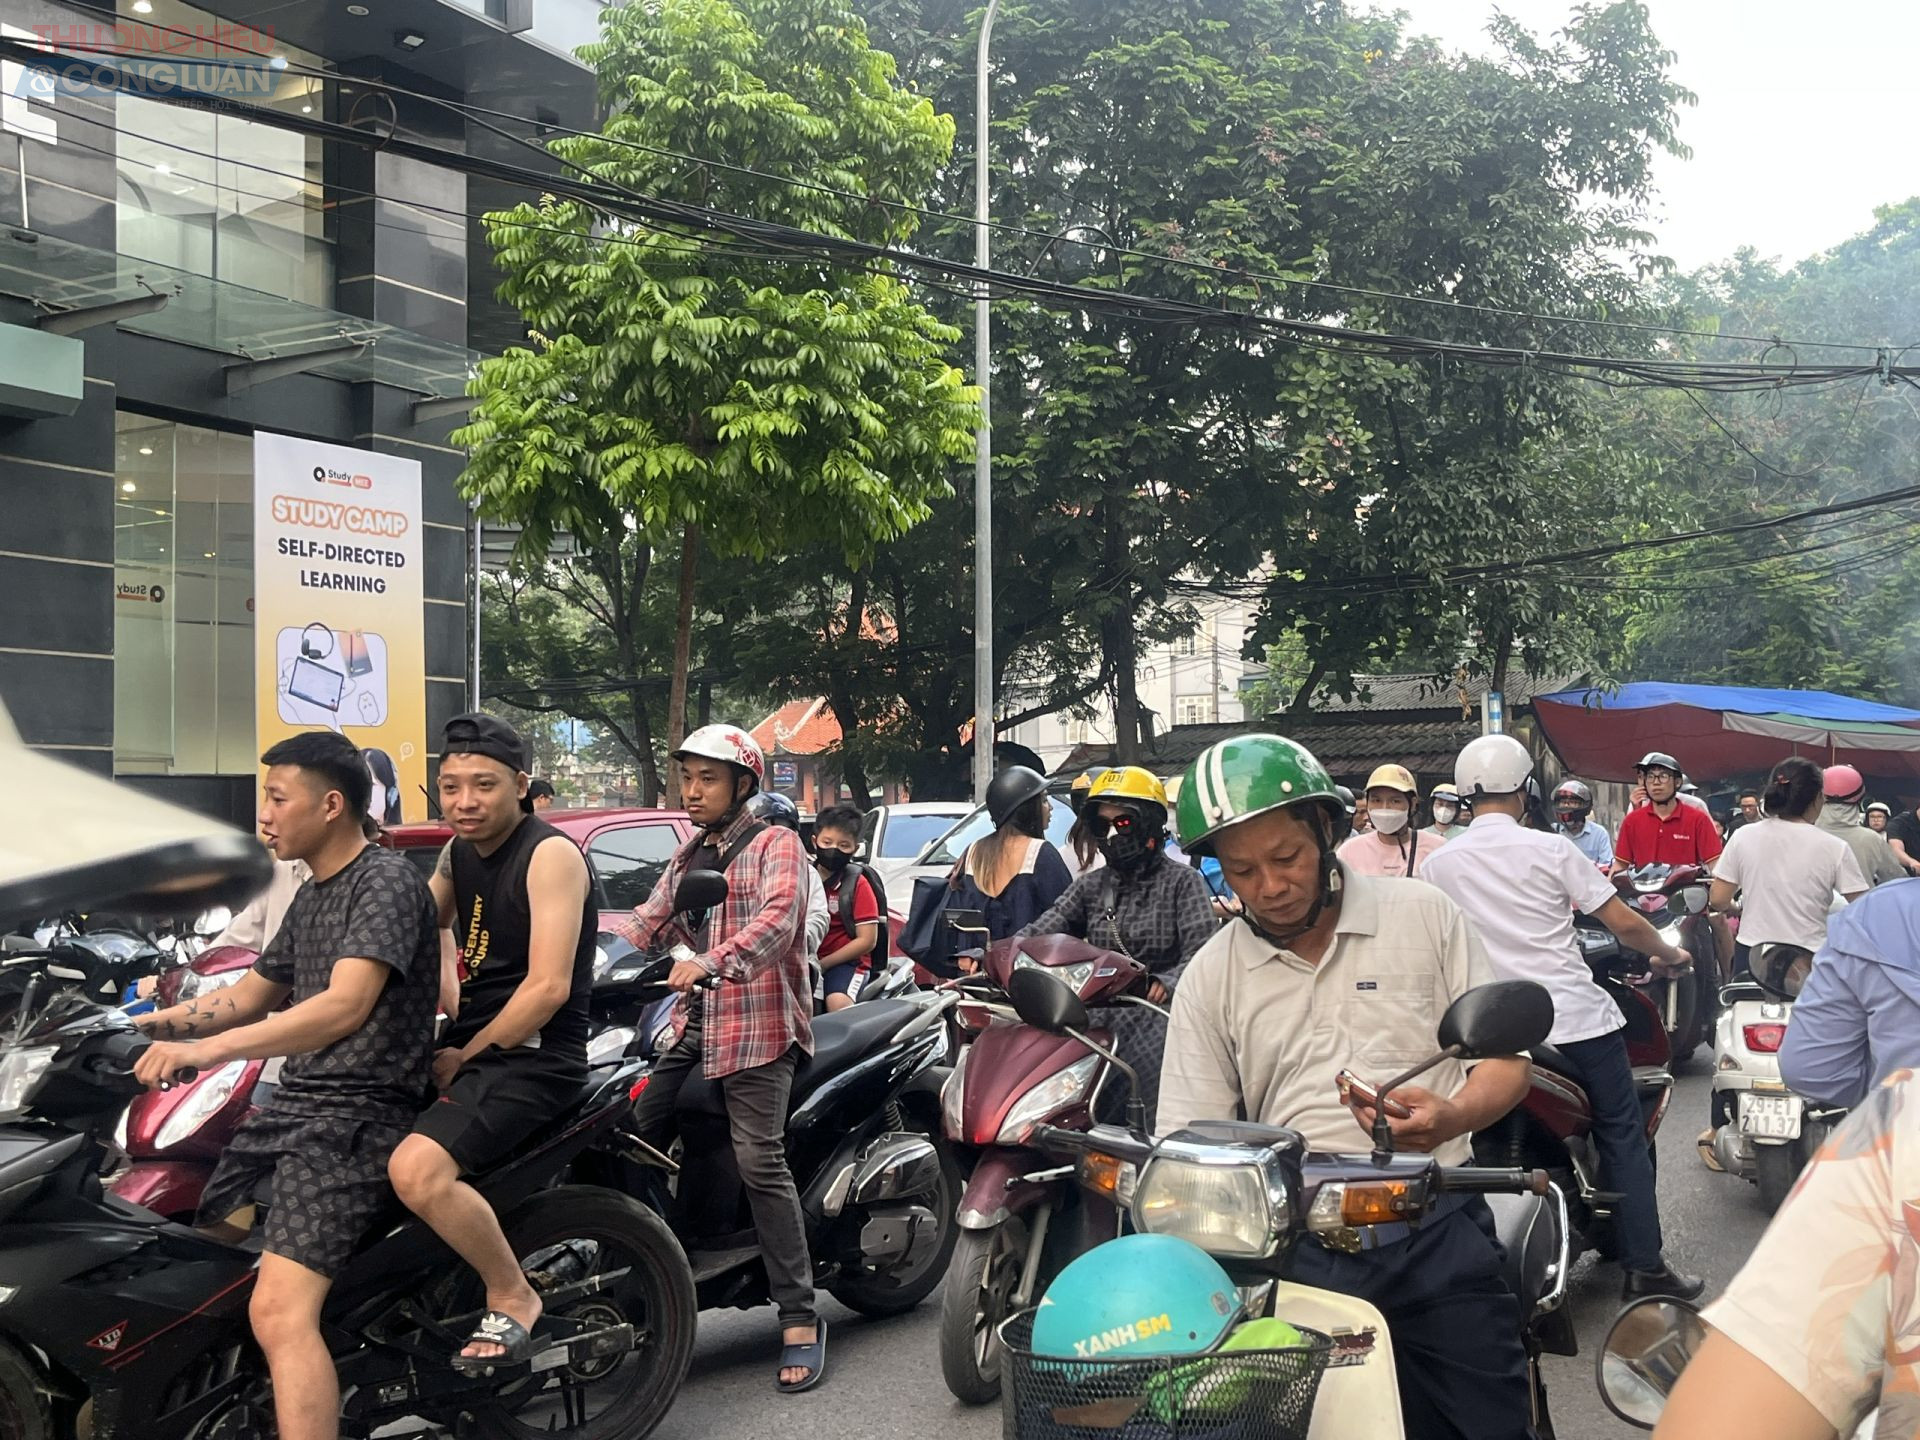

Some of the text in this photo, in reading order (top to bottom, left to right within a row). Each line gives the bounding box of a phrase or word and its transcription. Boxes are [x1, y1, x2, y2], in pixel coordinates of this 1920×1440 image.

[328, 469, 352, 482] Study
[273, 496, 407, 537] STUDY CAMP
[278, 537, 405, 568] SELF-DIRECTED
[301, 570, 386, 594] LEARNING
[464, 894, 483, 958] CENTURY
[1742, 1114, 1797, 1136] 211.37
